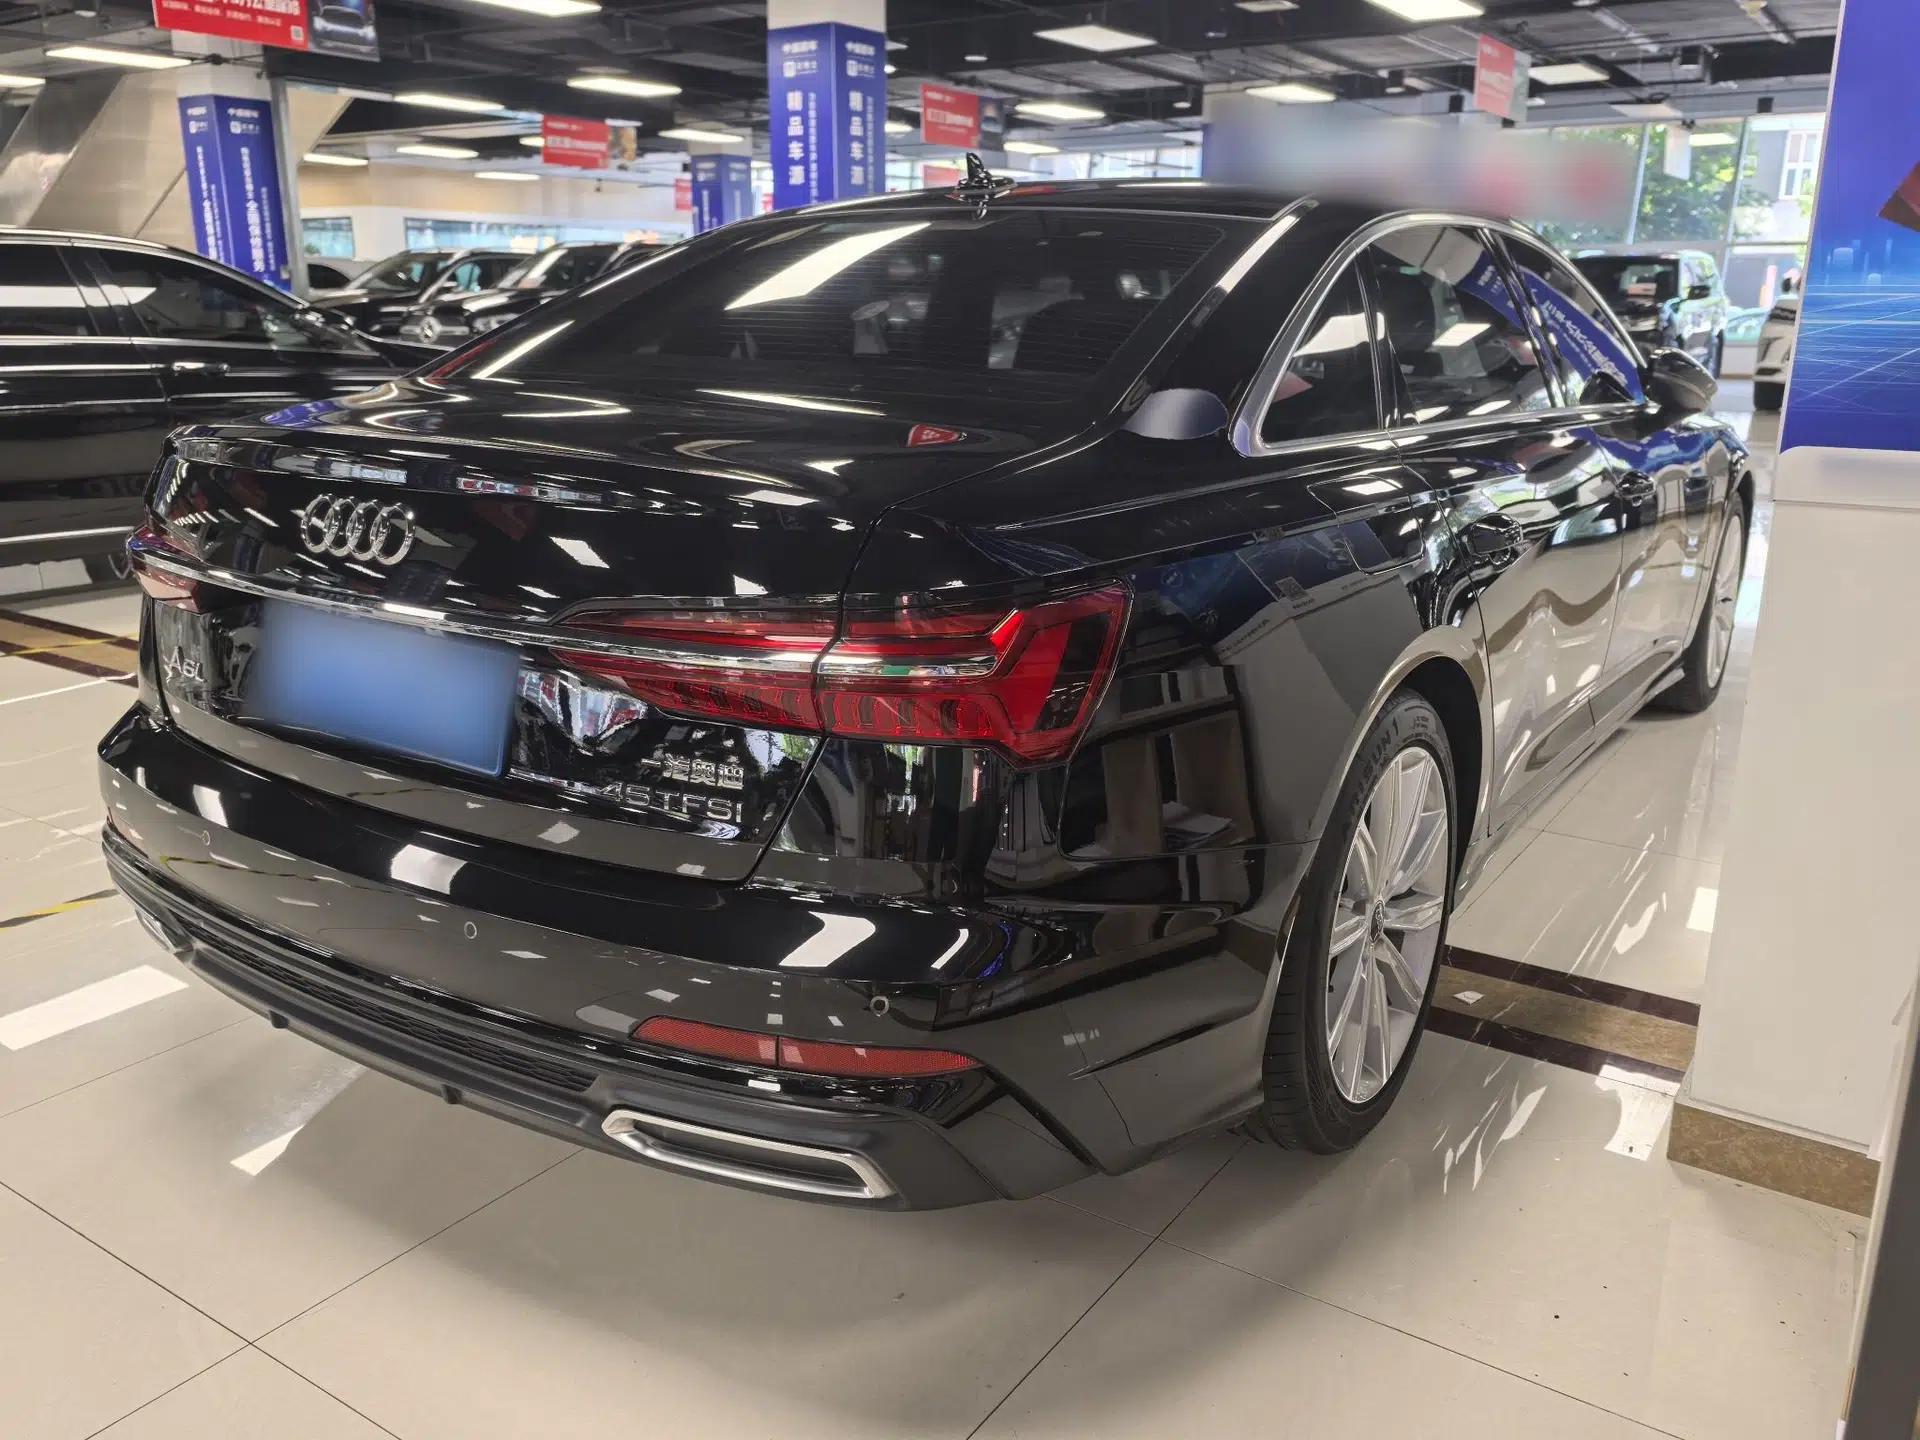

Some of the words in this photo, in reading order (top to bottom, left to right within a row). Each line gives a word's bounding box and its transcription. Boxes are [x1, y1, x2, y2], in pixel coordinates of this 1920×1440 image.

[166, 646, 204, 682] A6L
[599, 782, 650, 806] 45
[655, 789, 743, 823] TFSI
